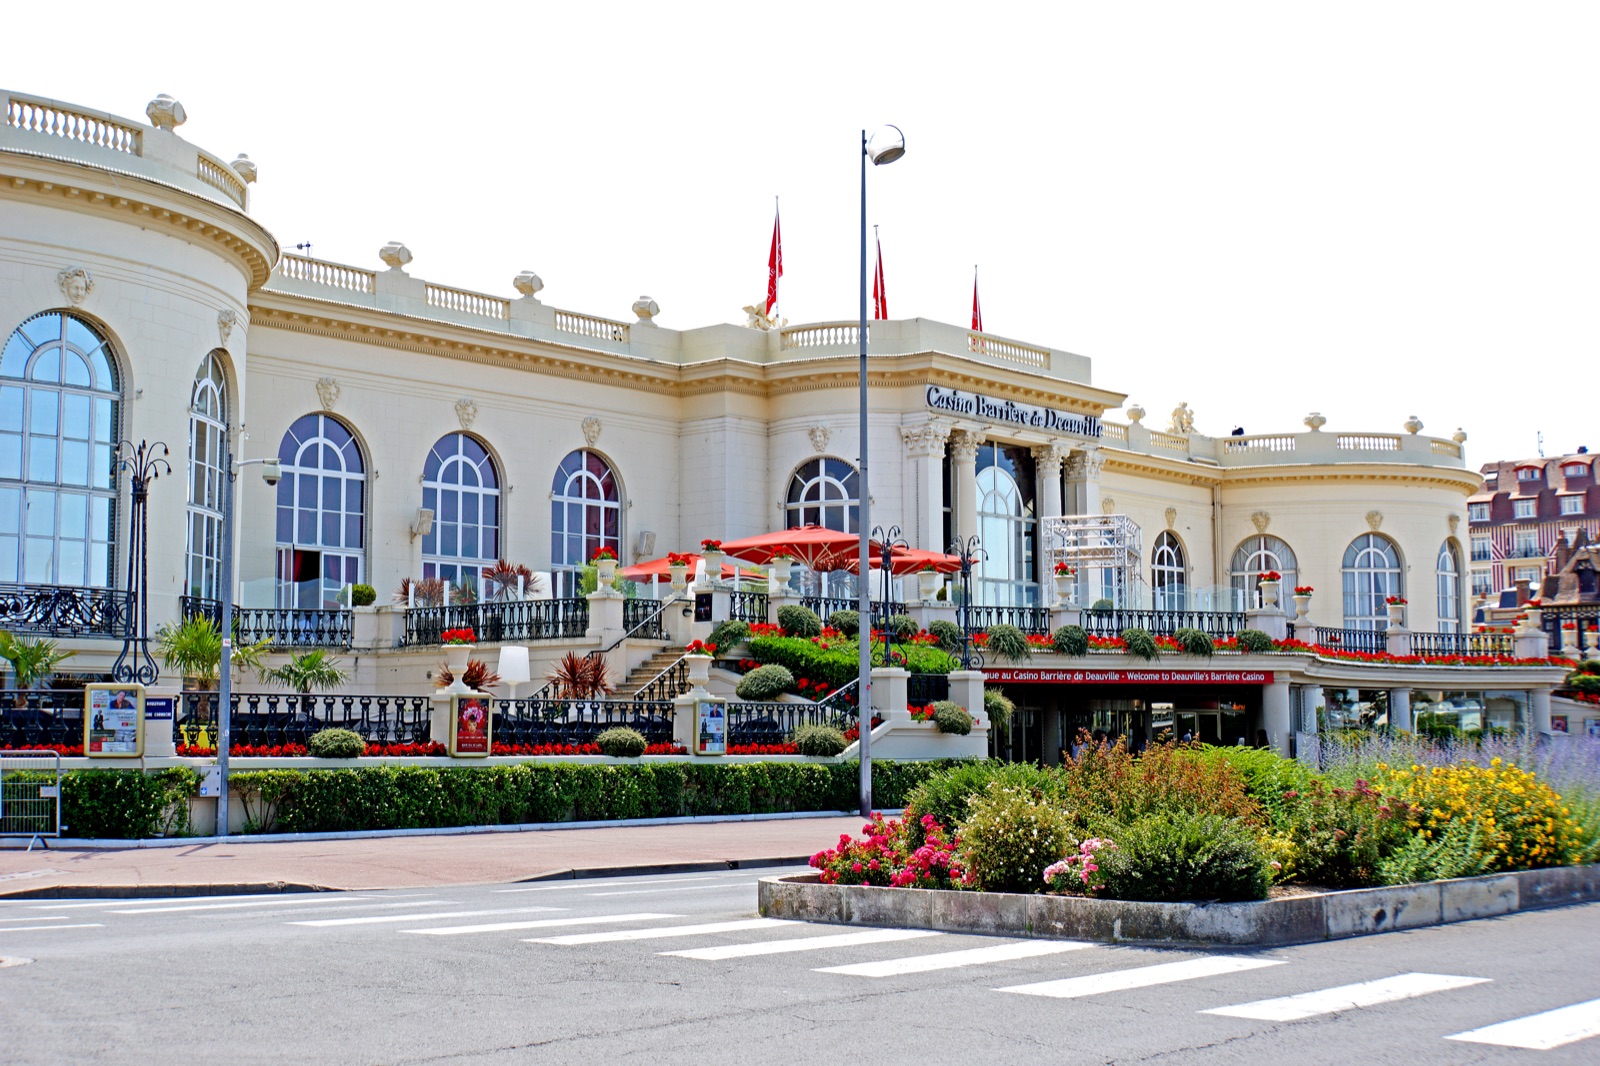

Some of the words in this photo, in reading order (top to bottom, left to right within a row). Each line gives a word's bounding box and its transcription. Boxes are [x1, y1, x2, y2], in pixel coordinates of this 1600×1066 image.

[926, 386, 974, 413] Casino
[976, 395, 1028, 425] Barrière
[1030, 410, 1043, 426] de
[1044, 408, 1103, 437] Deauville
[1001, 672, 1012, 680] au
[1013, 670, 1039, 680] Casino
[1040, 670, 1072, 681] Barrière
[1074, 671, 1083, 681] de
[1085, 671, 1119, 681] Deauville
[1127, 671, 1159, 681] Welcome
[1162, 672, 1169, 681] to
[1171, 671, 1209, 681] Deauville's
[1211, 671, 1240, 681] Barrière
[1241, 671, 1265, 682] Casino
